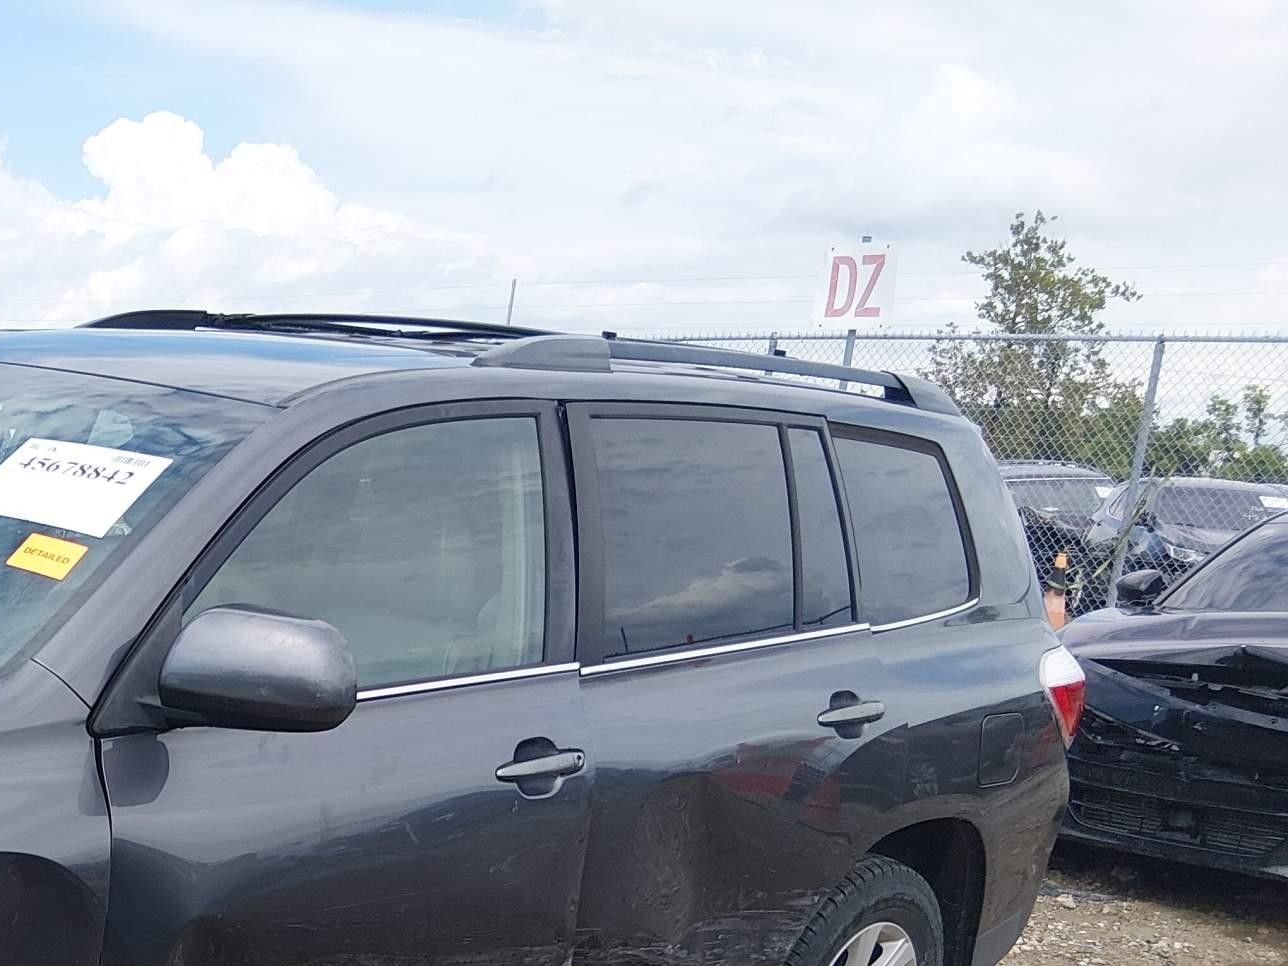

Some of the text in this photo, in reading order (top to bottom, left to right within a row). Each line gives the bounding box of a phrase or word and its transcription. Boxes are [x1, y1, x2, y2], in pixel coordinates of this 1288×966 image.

[824, 254, 886, 318] DZ
[19, 456, 135, 485] 45678842
[23, 546, 71, 565] DETAILED
